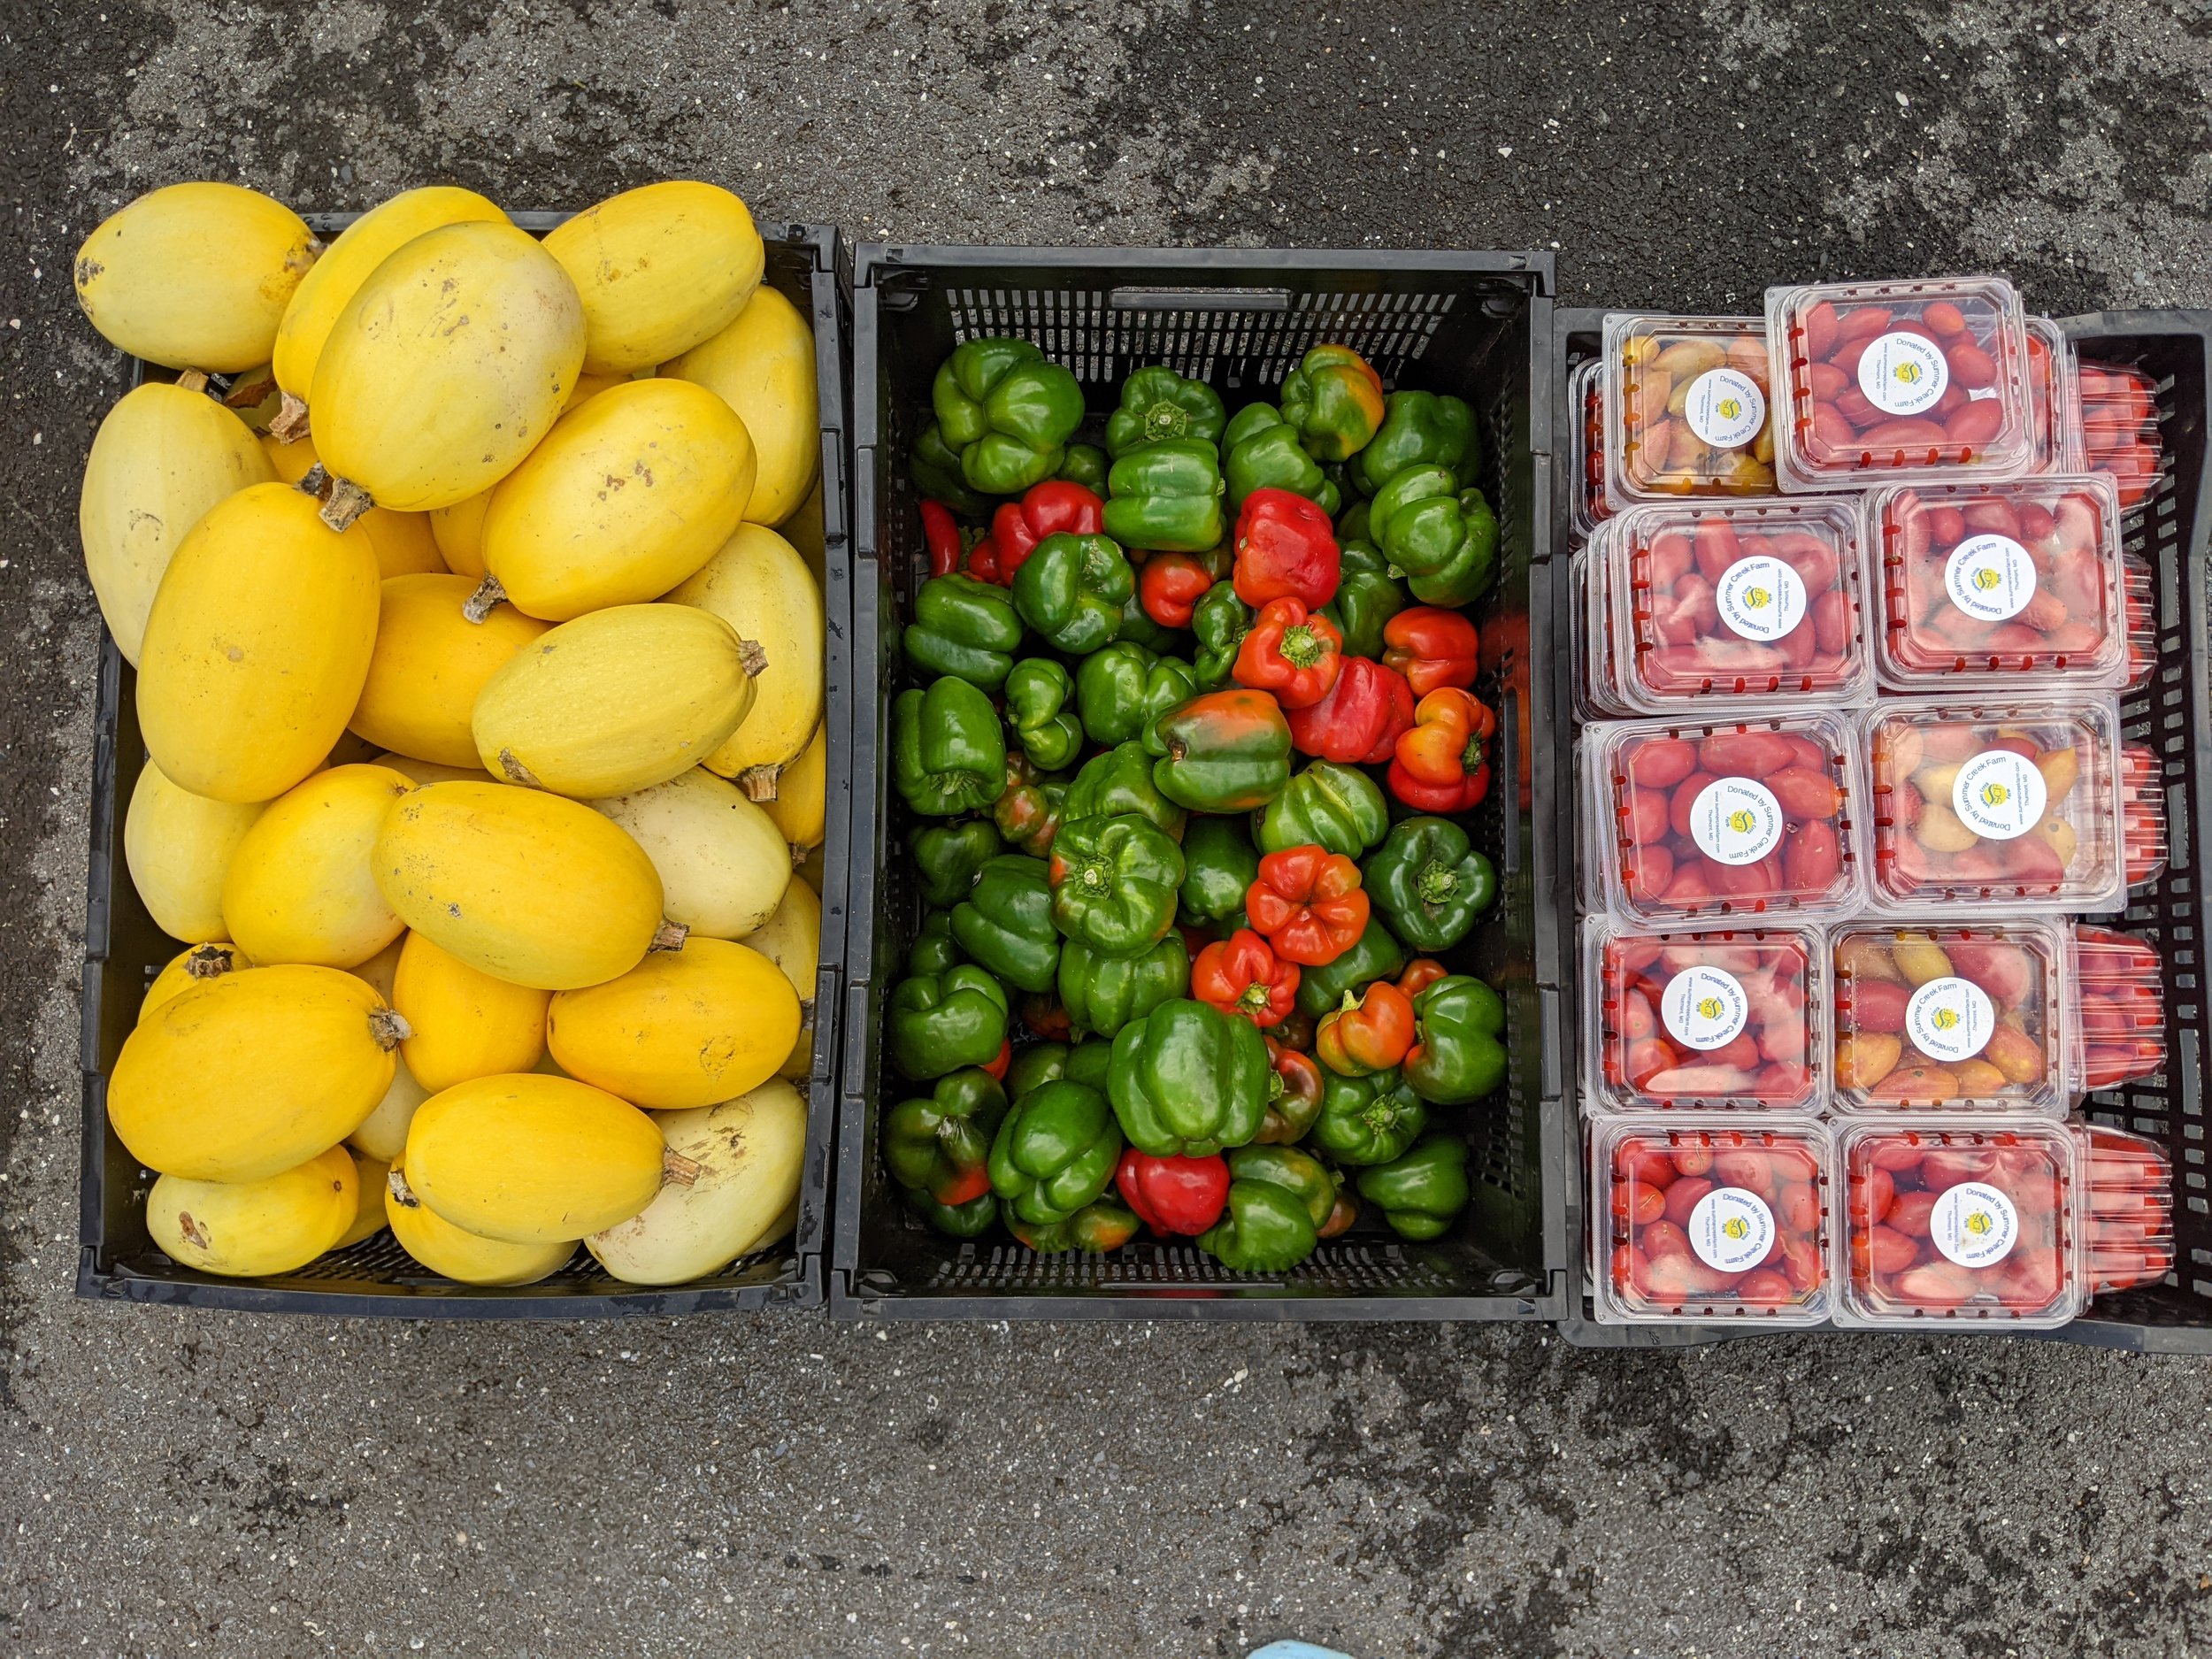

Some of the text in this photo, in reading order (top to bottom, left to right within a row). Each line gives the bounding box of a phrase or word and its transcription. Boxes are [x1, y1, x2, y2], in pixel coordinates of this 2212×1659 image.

[1897, 339, 1926, 353] Donated
[1925, 351, 1933, 360] by
[1916, 388, 1934, 403] Creek
[1720, 376, 1746, 392] Donated
[1734, 426, 1751, 439] Creek
[1976, 543, 1996, 552] Farm
[1958, 549, 1977, 565] Creek
[1731, 566, 1751, 582] Creek
[1954, 566, 1964, 595] Summer
[1725, 582, 1734, 611] Summer
[1732, 611, 1740, 620] by
[1971, 602, 2001, 614] Donated
[1740, 618, 1770, 634] Donated
[1727, 786, 1758, 800] Donated
[1962, 757, 2010, 831] Donated by Summer Creek Farm
[1758, 798, 1767, 807] by
[1764, 806, 1774, 836] Summer
[1750, 837, 1769, 854] Creek
[1701, 973, 1730, 989] Donated
[1727, 987, 1736, 996] by
[1919, 988, 1939, 1004] Creek
[1915, 1005, 1924, 1033] Summer
[1715, 1025, 1734, 1041] Creek
[1929, 1040, 1958, 1053] Donated
[1723, 1194, 1753, 1207] Donated
[1966, 1188, 1995, 1202] Donated
[1757, 1213, 1766, 1242] Summer
[2001, 1210, 2009, 1239] Summer
[1743, 1243, 1762, 1258] Creek
[1985, 1240, 2005, 1255] Creek
